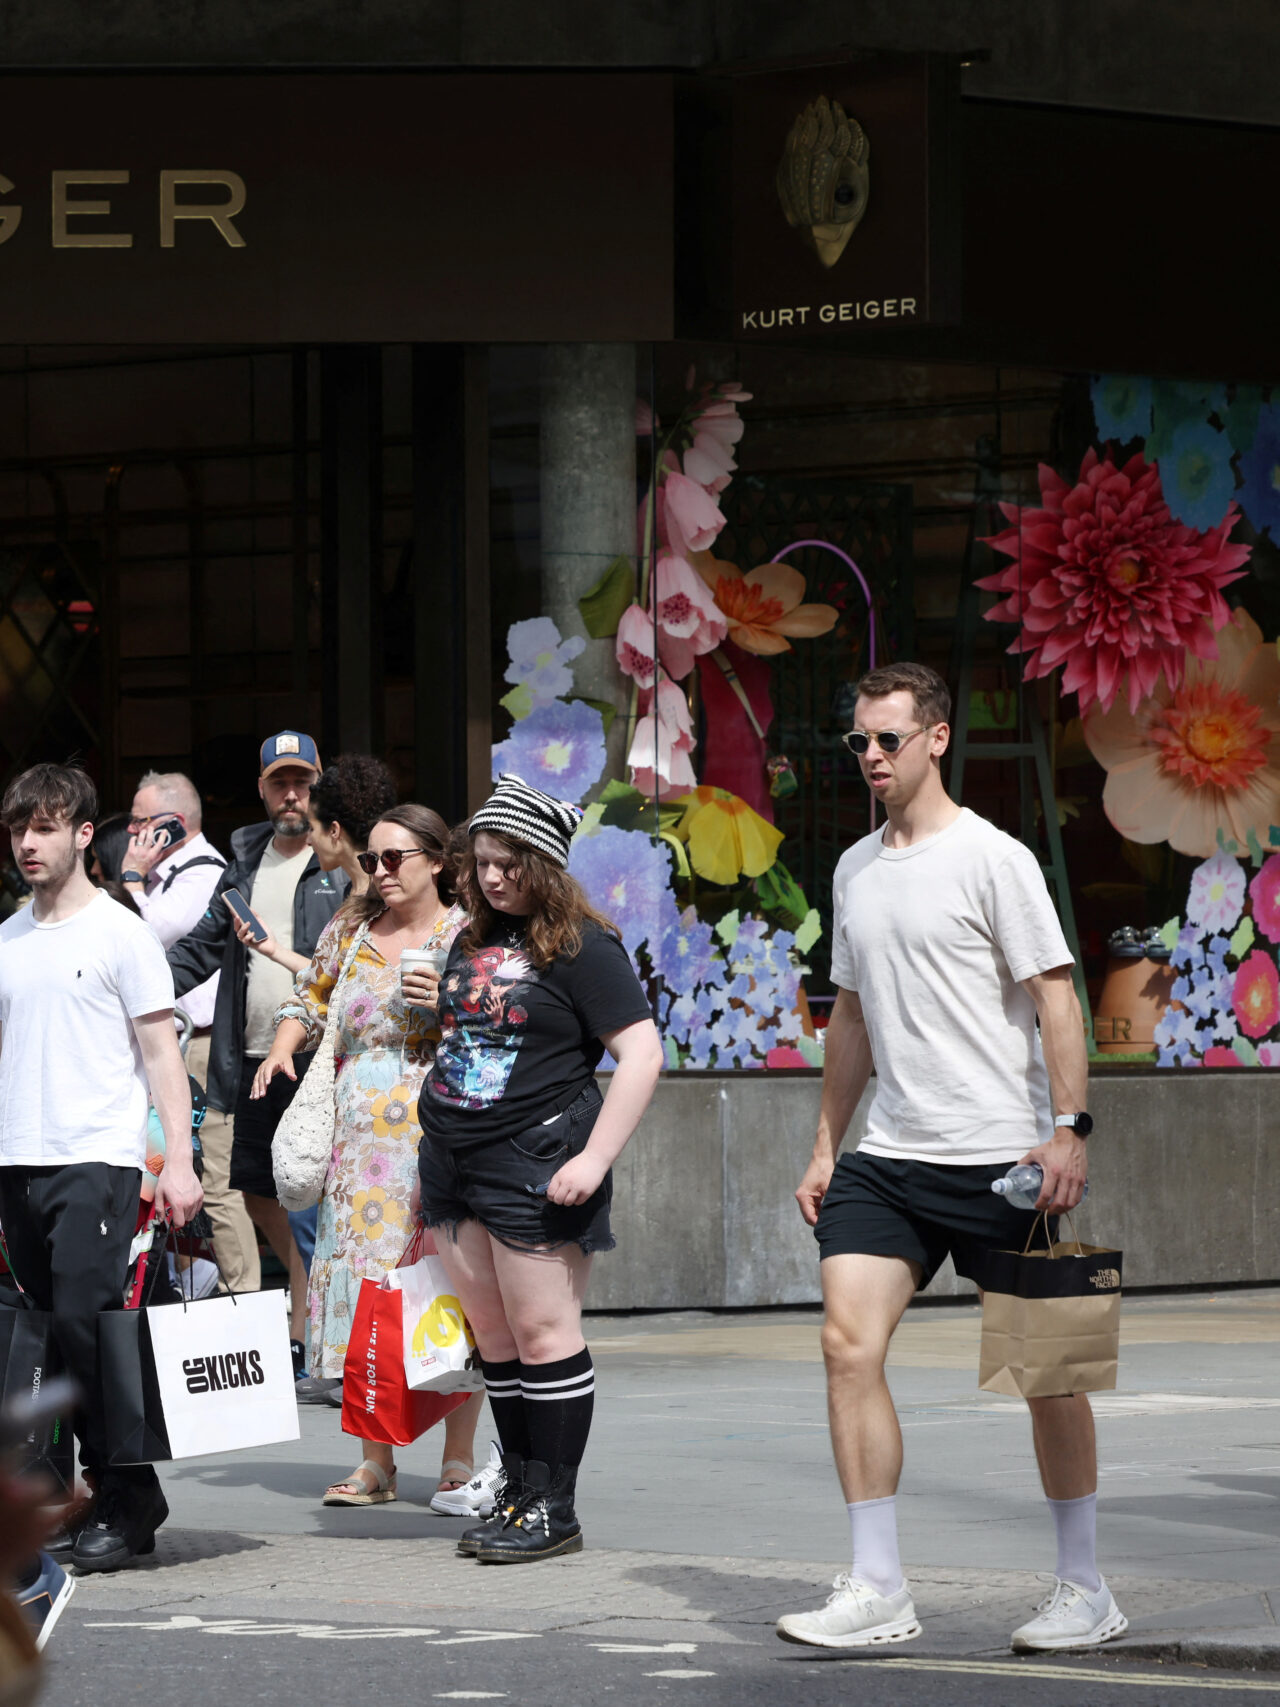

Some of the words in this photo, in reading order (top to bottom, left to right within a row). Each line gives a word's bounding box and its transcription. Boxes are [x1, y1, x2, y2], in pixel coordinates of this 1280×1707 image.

[742, 306, 811, 329] KURT
[819, 297, 917, 323] GEIGER
[1097, 1269, 1112, 1277] THE
[1089, 1274, 1112, 1283] NORTH
[1095, 1281, 1112, 1289] FACE
[366, 1362, 377, 1386] FOR
